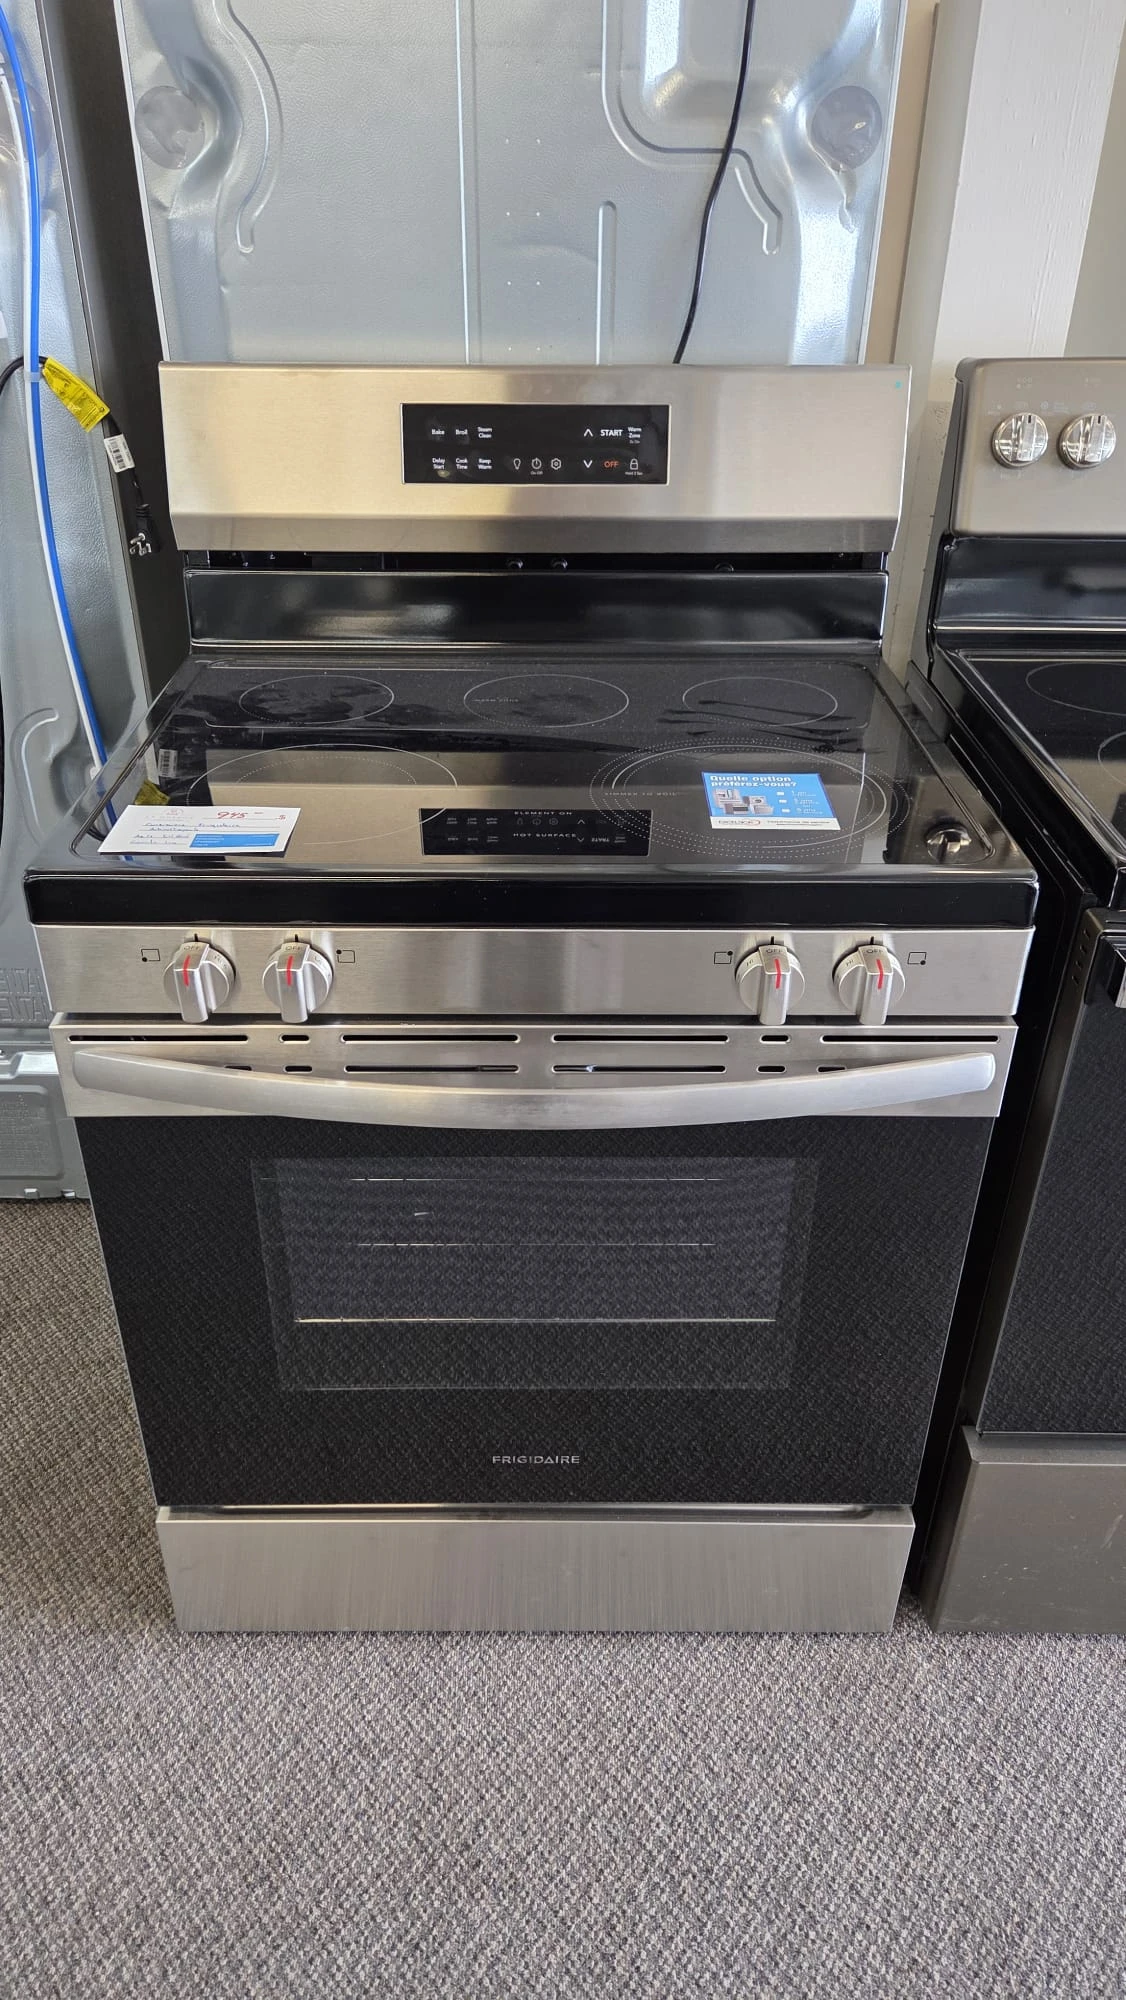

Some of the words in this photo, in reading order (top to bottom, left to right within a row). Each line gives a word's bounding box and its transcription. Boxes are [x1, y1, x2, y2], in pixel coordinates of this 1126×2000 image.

[600, 429, 624, 437] START
[603, 460, 619, 468] OFF
[709, 774, 749, 782] Quelle
[752, 775, 792, 783] option
[492, 1455, 580, 1464] FRIGIDAIRE
